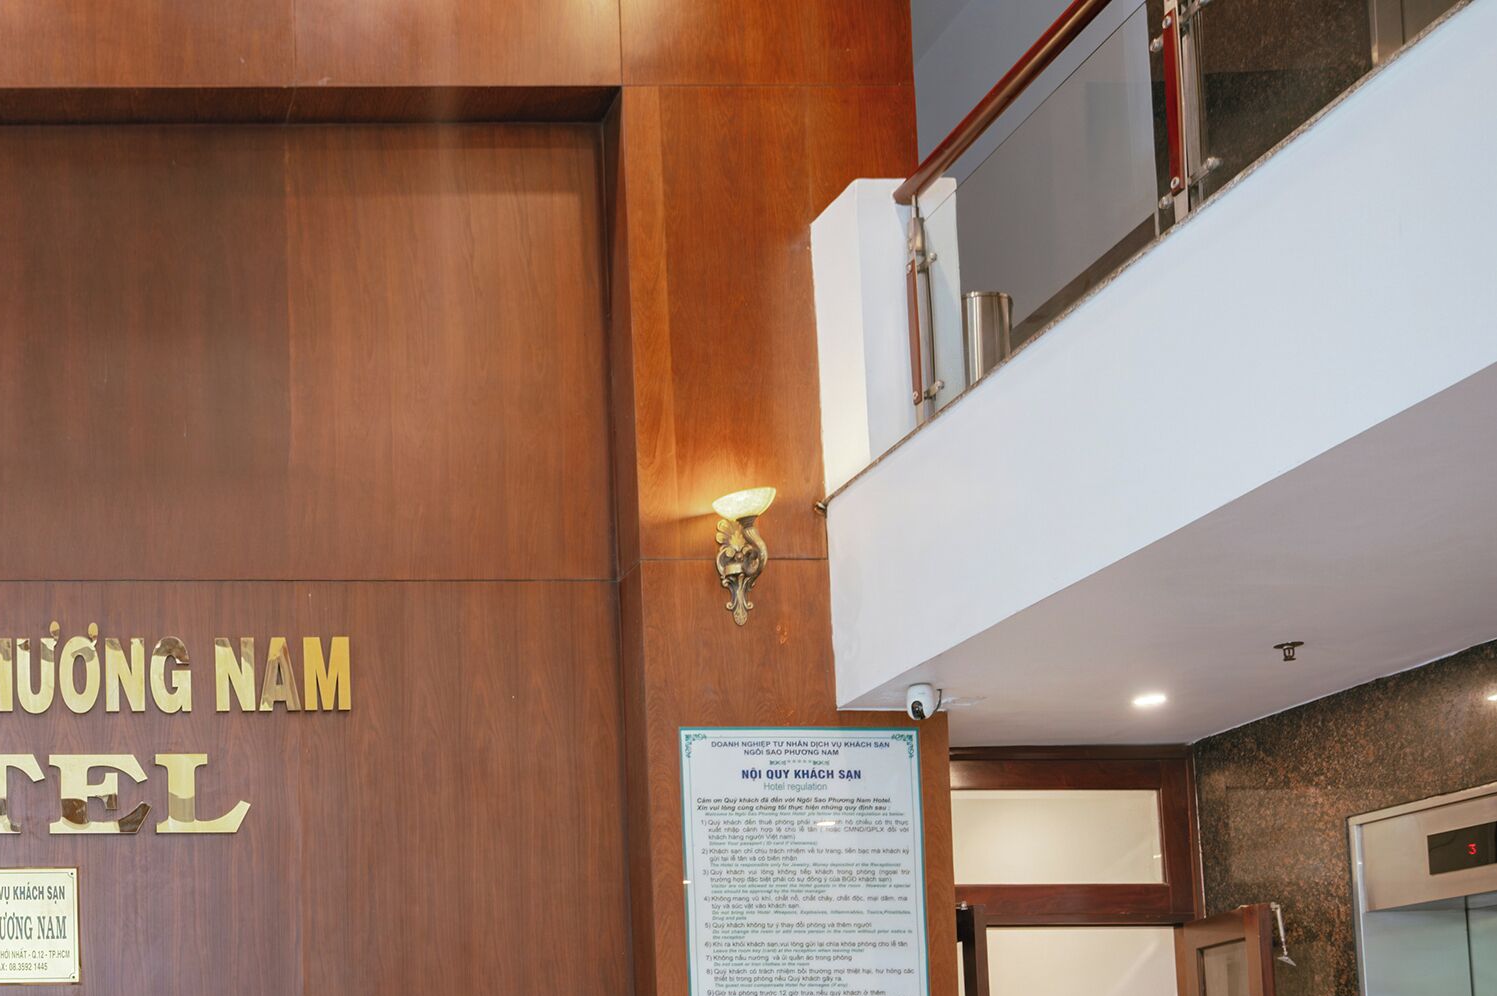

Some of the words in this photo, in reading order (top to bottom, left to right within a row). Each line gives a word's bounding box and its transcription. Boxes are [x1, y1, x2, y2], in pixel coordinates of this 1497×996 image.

[215, 636, 352, 712] NAM
[742, 767, 761, 781] NỘI
[767, 770, 789, 780] QUY
[795, 767, 834, 779] KHÁCH
[839, 770, 861, 781] SẠN
[764, 782, 784, 790] Hotel
[788, 783, 827, 792] regulation
[1468, 844, 1477, 855] 3
[13, 882, 44, 900] KHÁCH
[47, 886, 65, 904] SẠN
[37, 916, 67, 939] NAM
